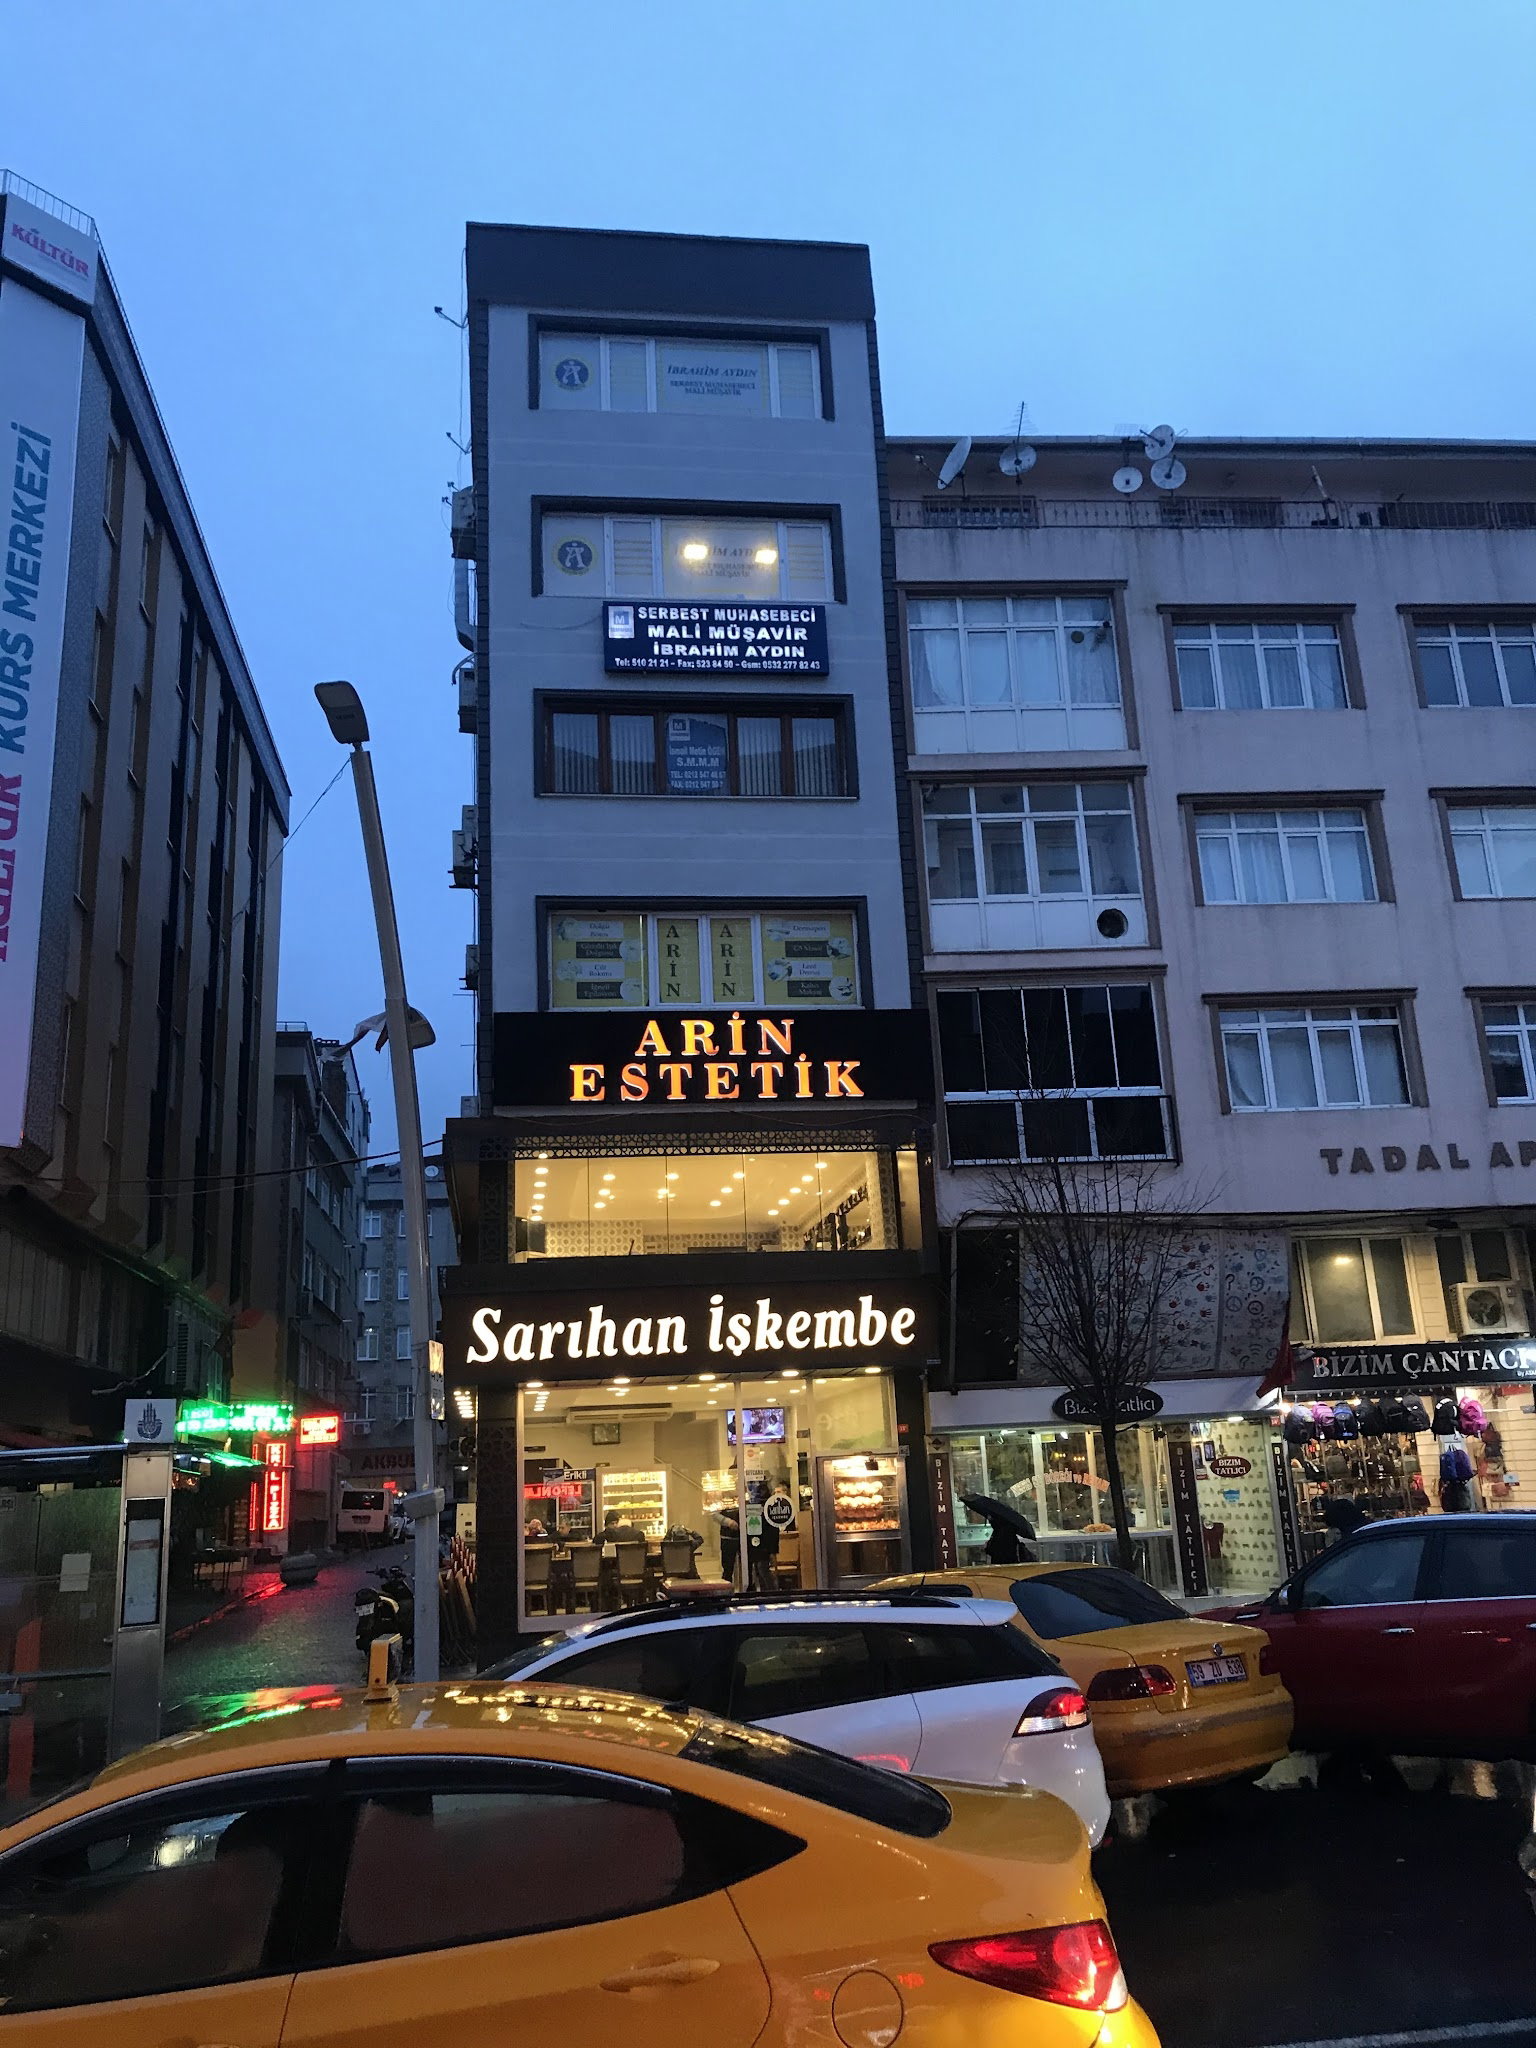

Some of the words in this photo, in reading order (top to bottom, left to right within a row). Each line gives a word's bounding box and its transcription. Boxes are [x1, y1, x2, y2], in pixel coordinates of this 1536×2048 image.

[667, 365, 719, 377] İBRAHİM
[721, 368, 758, 378] AYDIN
[2, 422, 52, 621] MERKEZİ
[638, 606, 709, 621] SERBEST
[714, 607, 816, 622] MUHASEBECİ
[648, 623, 701, 639] MALİ
[708, 624, 808, 642] MÜŞAVİR
[615, 658, 631, 667] Tel:
[632, 658, 647, 667] 510
[648, 659, 658, 668] 21
[659, 659, 669, 668] 21
[696, 659, 711, 669] 523
[712, 660, 722, 669] 84
[723, 660, 734, 669] 50
[741, 659, 762, 669] Gsm:
[763, 660, 782, 670] 0532
[783, 660, 798, 670] 277
[799, 660, 809, 670] 82
[810, 660, 820, 670] 43
[653, 641, 739, 657] İBRAHİM
[745, 645, 805, 658] AYDIN
[666, 924, 681, 998] ARİN
[719, 923, 737, 997] ARİN
[634, 1011, 795, 1057] ARİN
[569, 1053, 865, 1102] ESTETİK
[1320, 1143, 1470, 1175] TADAL
[466, 1305, 689, 1364] Sarıhan
[708, 1293, 916, 1357] İşkembe
[1312, 1349, 1397, 1379] BİZİM
[1402, 1347, 1530, 1379] ÇANTACI
[1184, 1513, 1198, 1592] TATLICI
